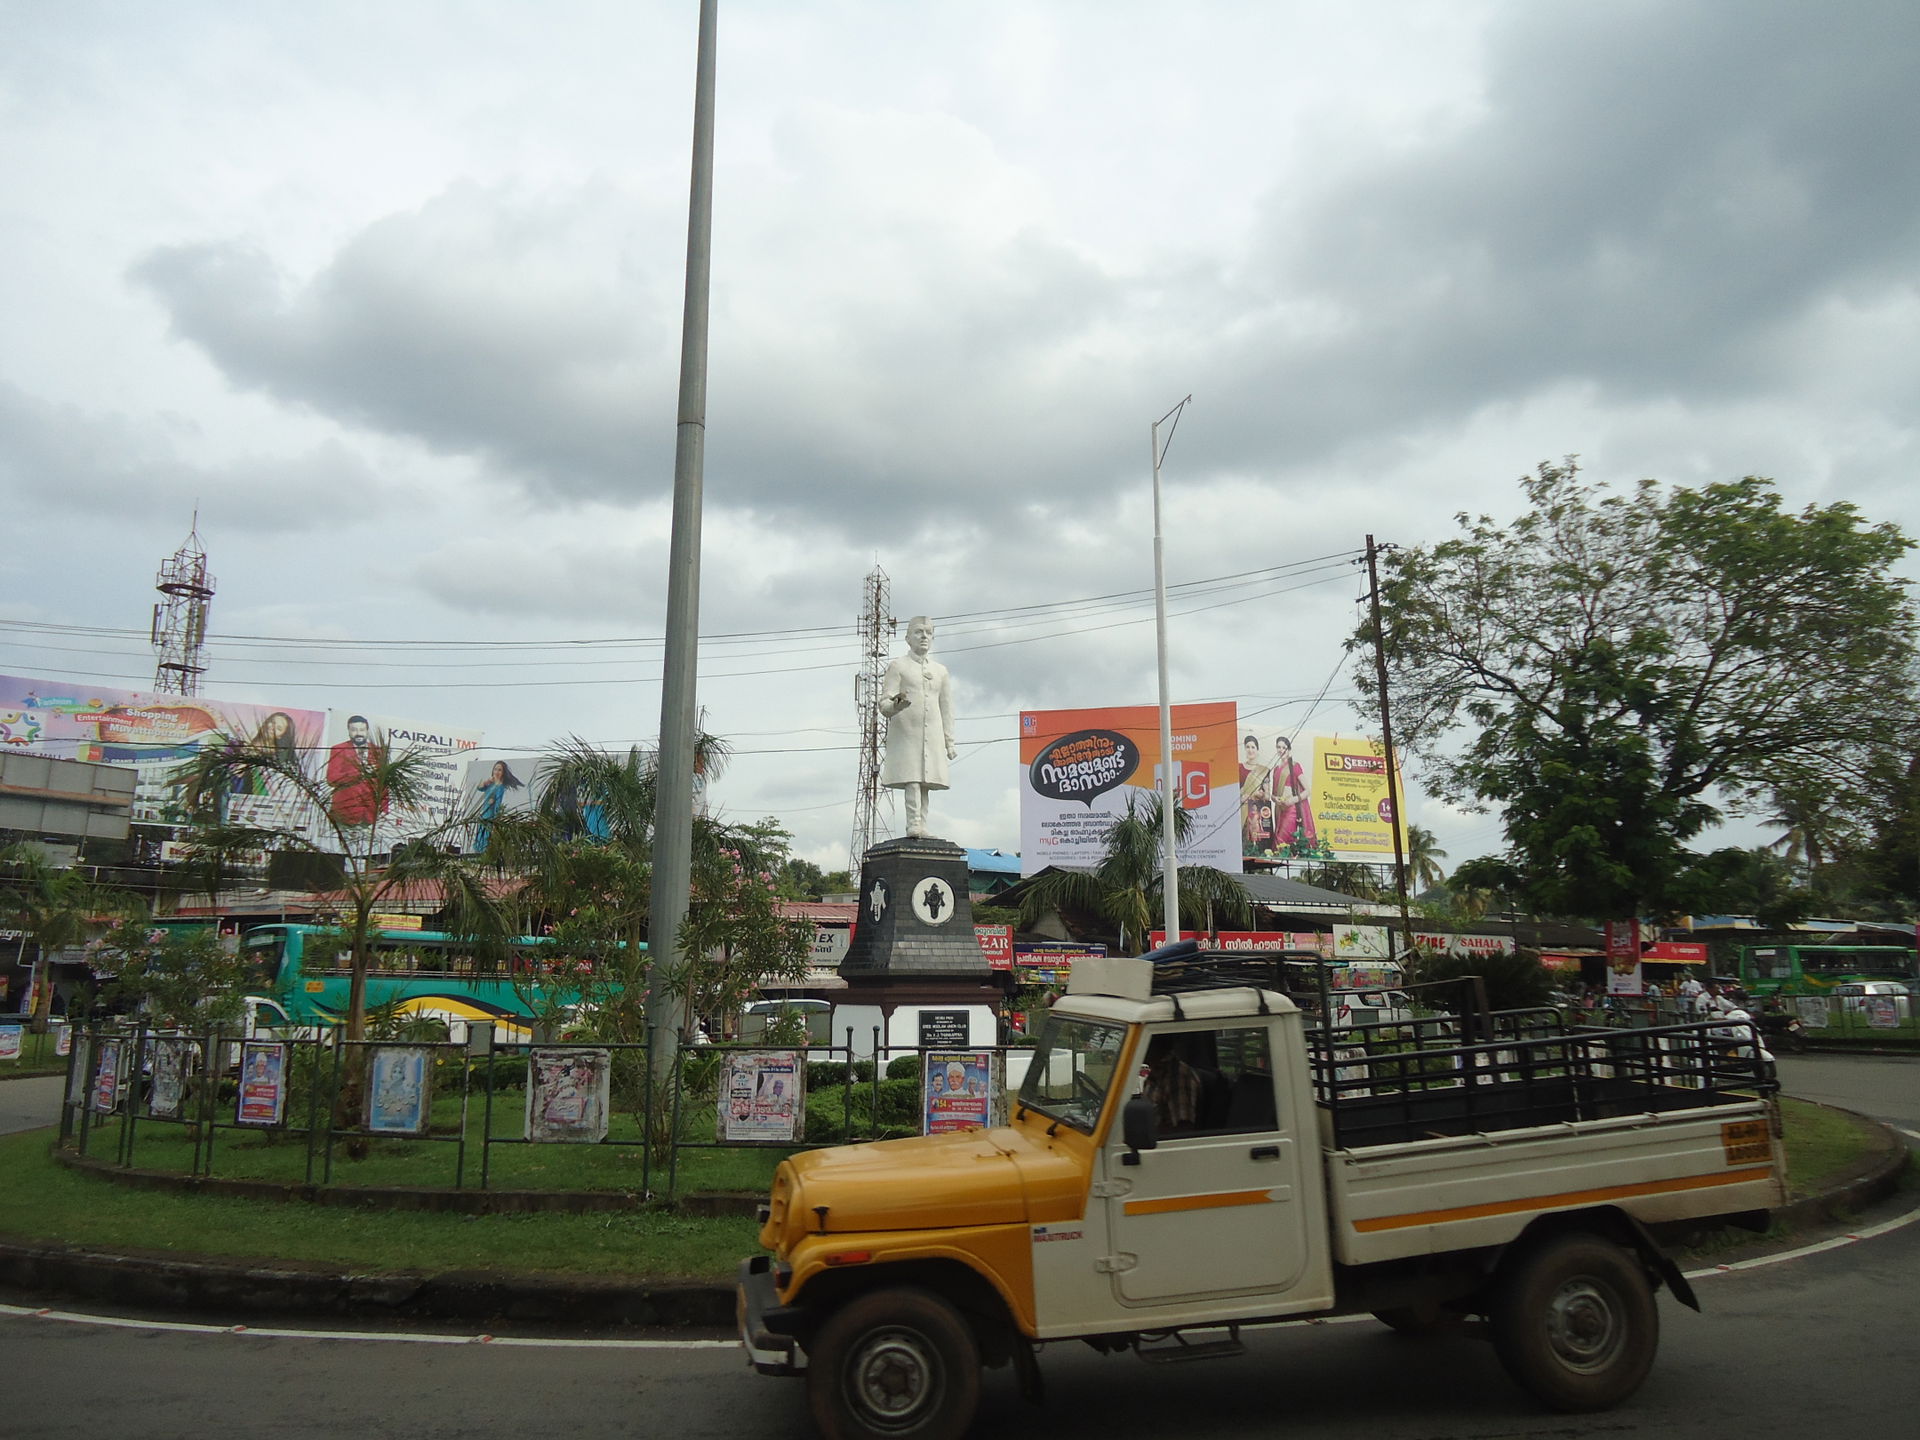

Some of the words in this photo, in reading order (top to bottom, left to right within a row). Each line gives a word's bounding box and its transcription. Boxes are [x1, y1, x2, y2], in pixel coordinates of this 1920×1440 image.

[77, 714, 133, 726] Entertainment
[126, 708, 178, 722] Shopping
[388, 728, 453, 747] KAIRALI
[455, 738, 478, 749] TMT
[1170, 735, 1198, 743] OMING
[981, 937, 1009, 949] ZAR
[1461, 937, 1504, 949] SAHALA
